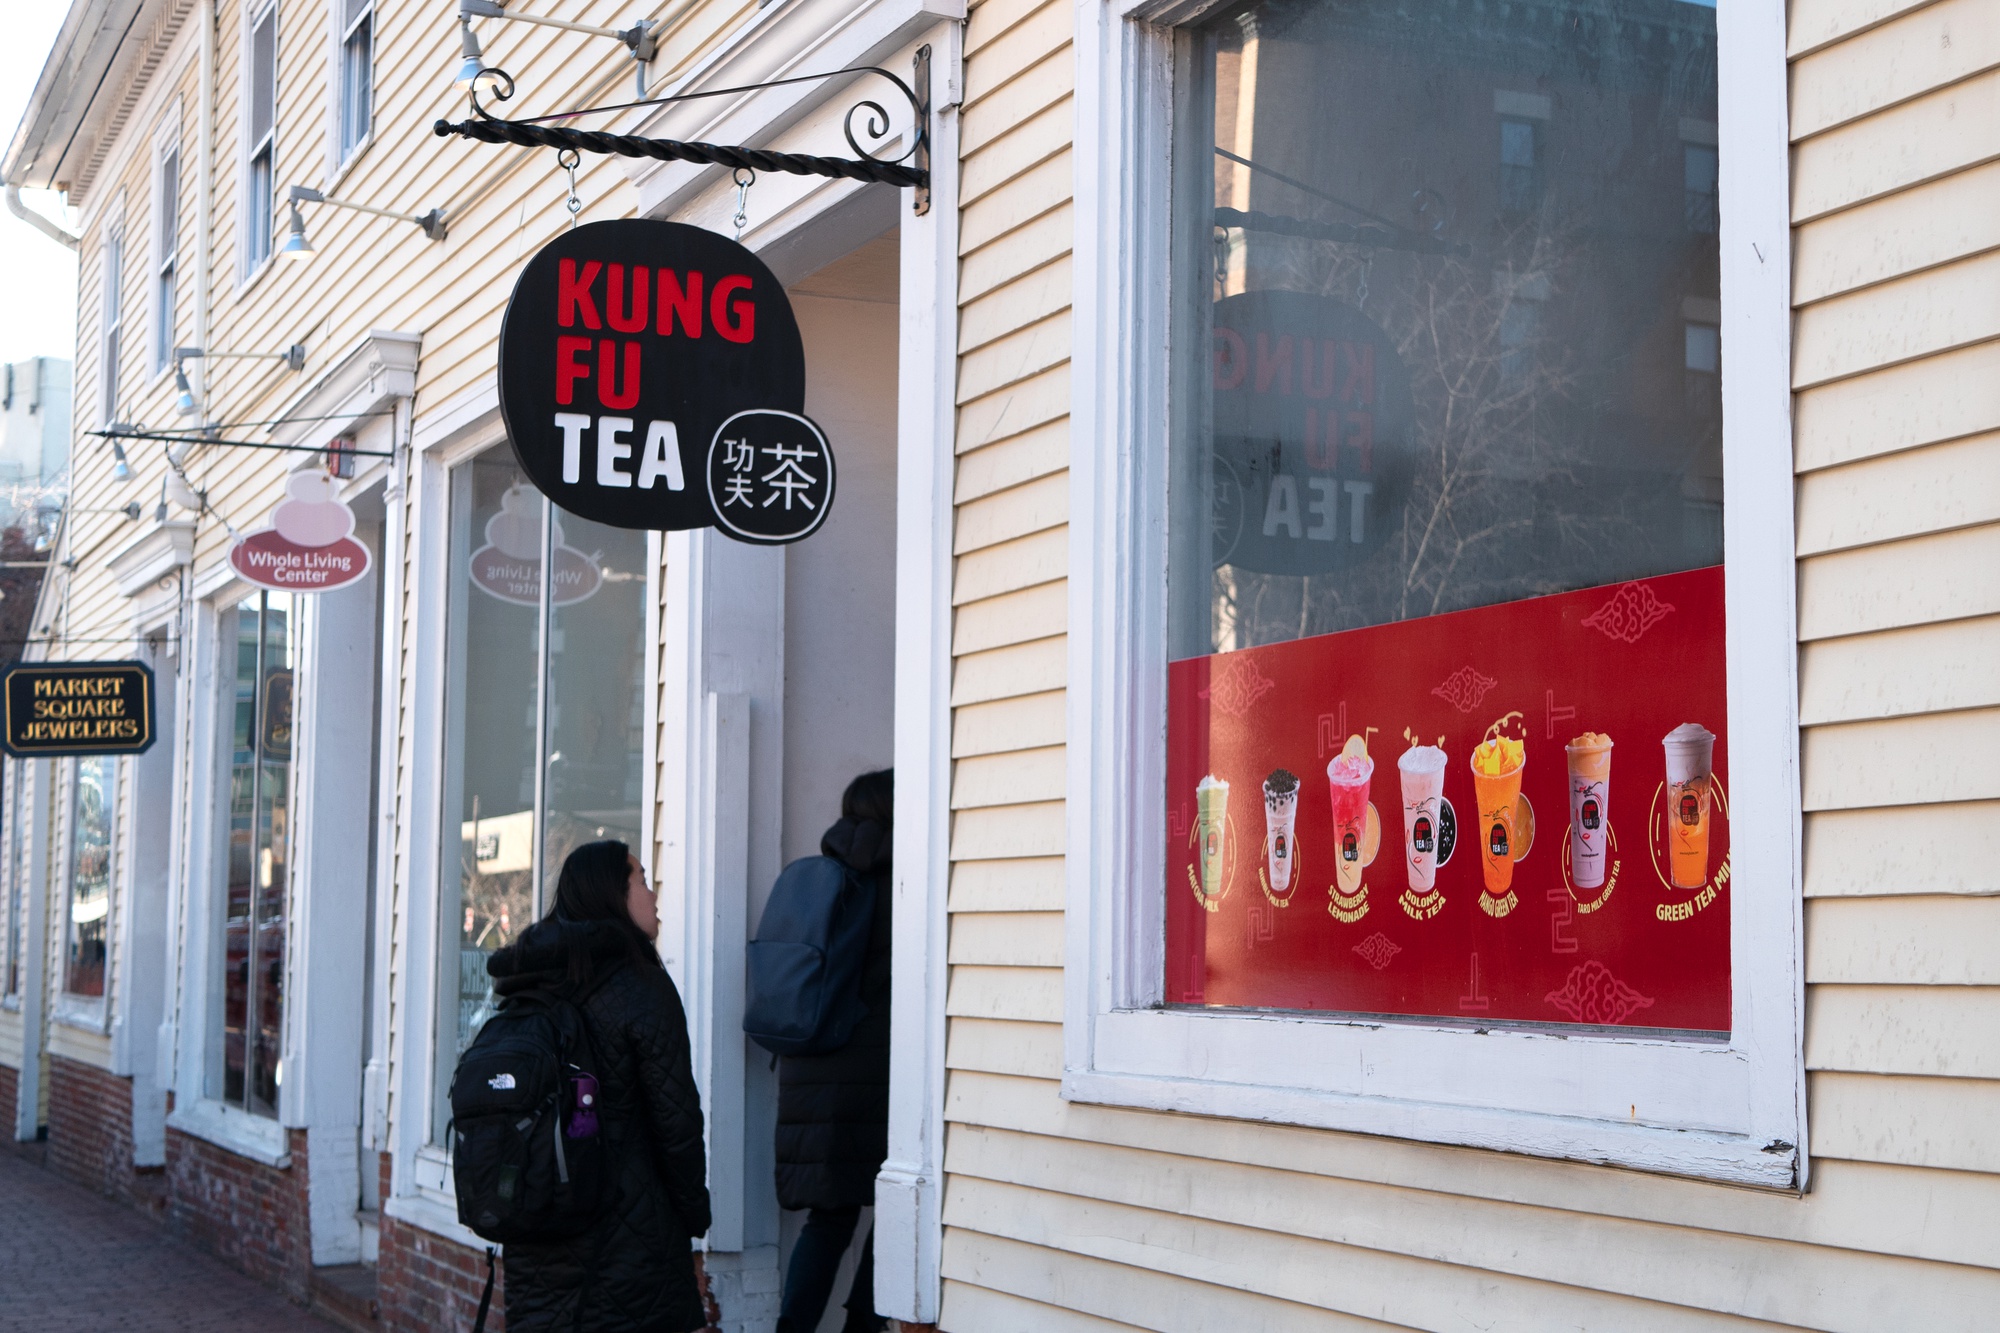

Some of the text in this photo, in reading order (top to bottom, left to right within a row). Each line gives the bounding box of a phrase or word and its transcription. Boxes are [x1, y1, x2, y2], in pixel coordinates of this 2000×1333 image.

[557, 257, 756, 344] KUNG
[555, 335, 642, 410] FU
[554, 412, 685, 491] TEA
[248, 551, 352, 572] Whole Living
[273, 567, 329, 583] Center
[34, 677, 125, 698] MARKET
[34, 698, 126, 720] SQUARE
[20, 719, 139, 741] JEWELERS
[1327, 883, 1369, 909] STRAWBERRY
[1404, 888, 1440, 908] OOLONG
[1577, 860, 1621, 914] TARO MILK GREEN TEA
[1327, 900, 1370, 923] LEMONADE
[1398, 894, 1447, 920] MILK TEA
[1478, 889, 1495, 917] MANGO
[1506, 889, 1519, 911] TEA
[1656, 899, 1694, 921] GREEN
[1694, 884, 1716, 912] TEA
